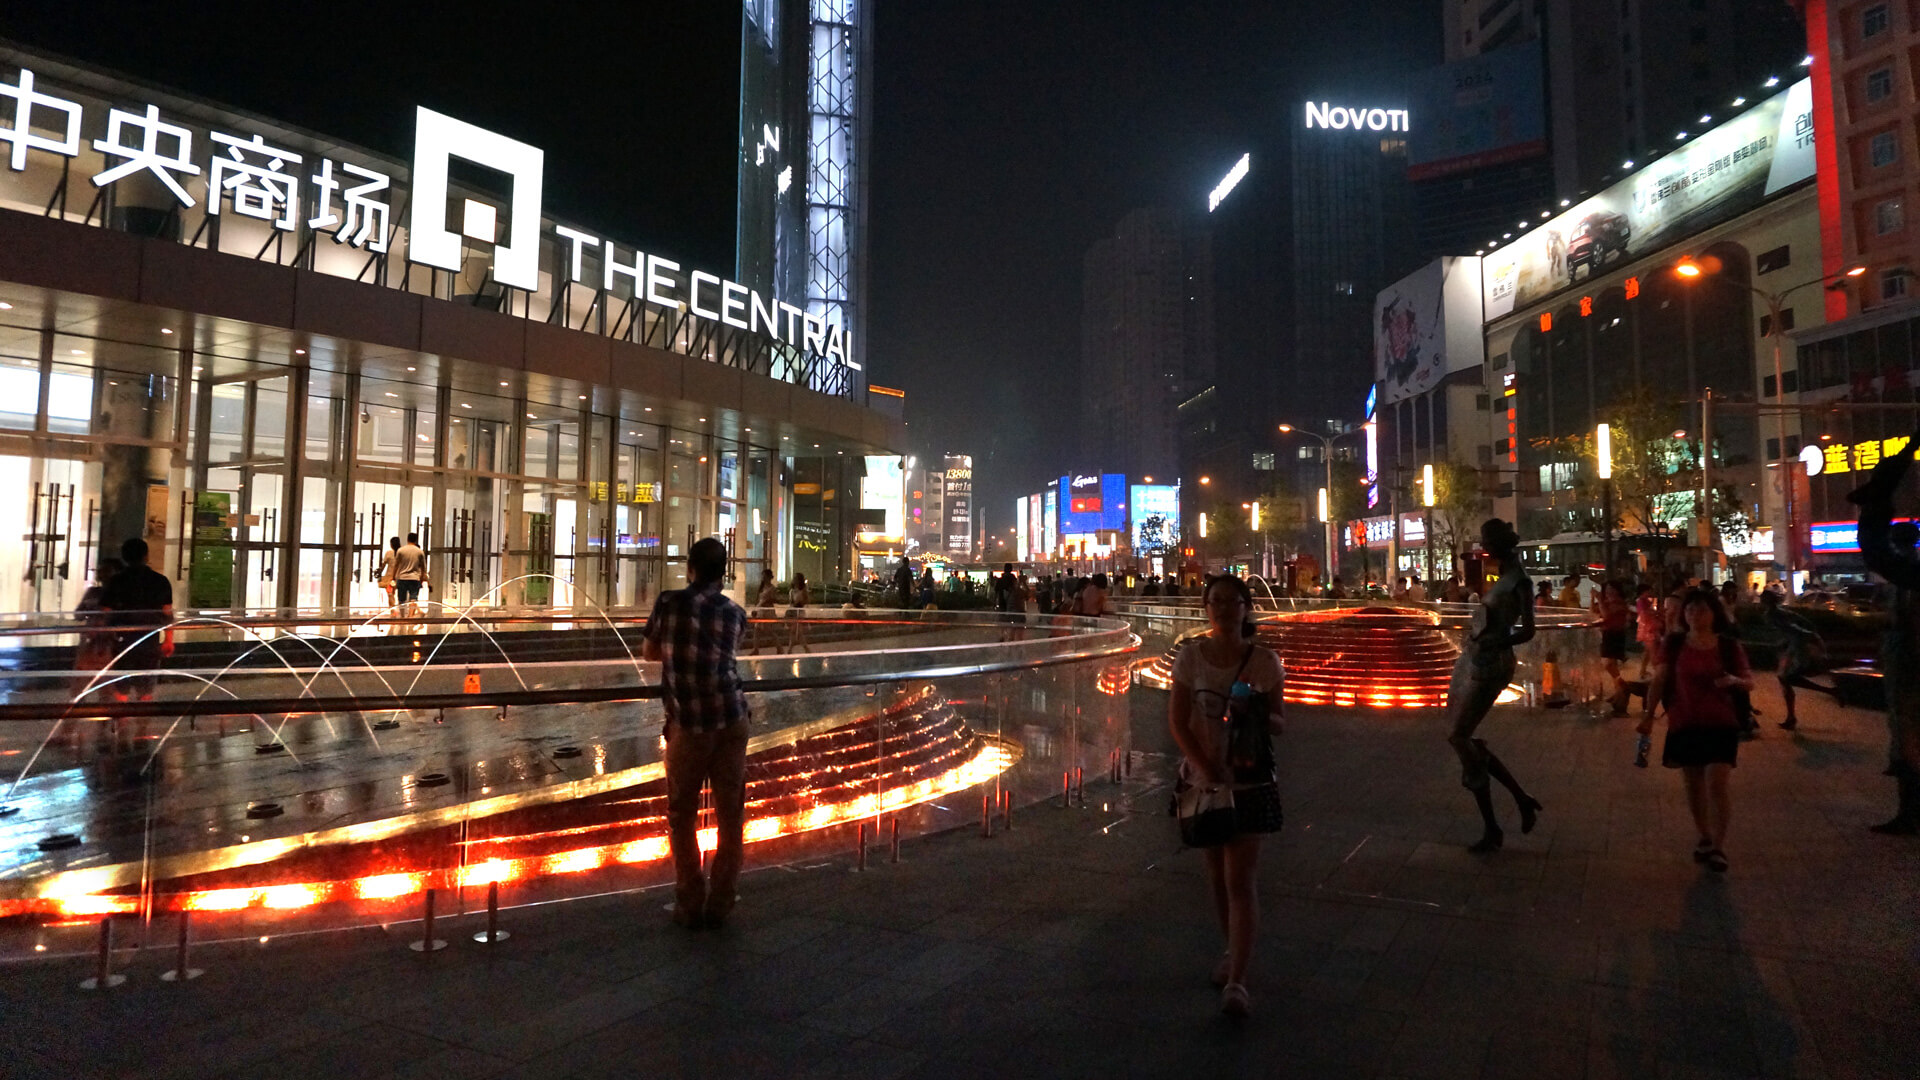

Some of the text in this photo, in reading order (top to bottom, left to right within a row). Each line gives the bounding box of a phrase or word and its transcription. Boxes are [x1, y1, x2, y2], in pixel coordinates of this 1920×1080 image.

[0, 68, 390, 254] 中央商场
[1306, 101, 1409, 131] NOVOT
[556, 225, 862, 371] THE CENTRAL
